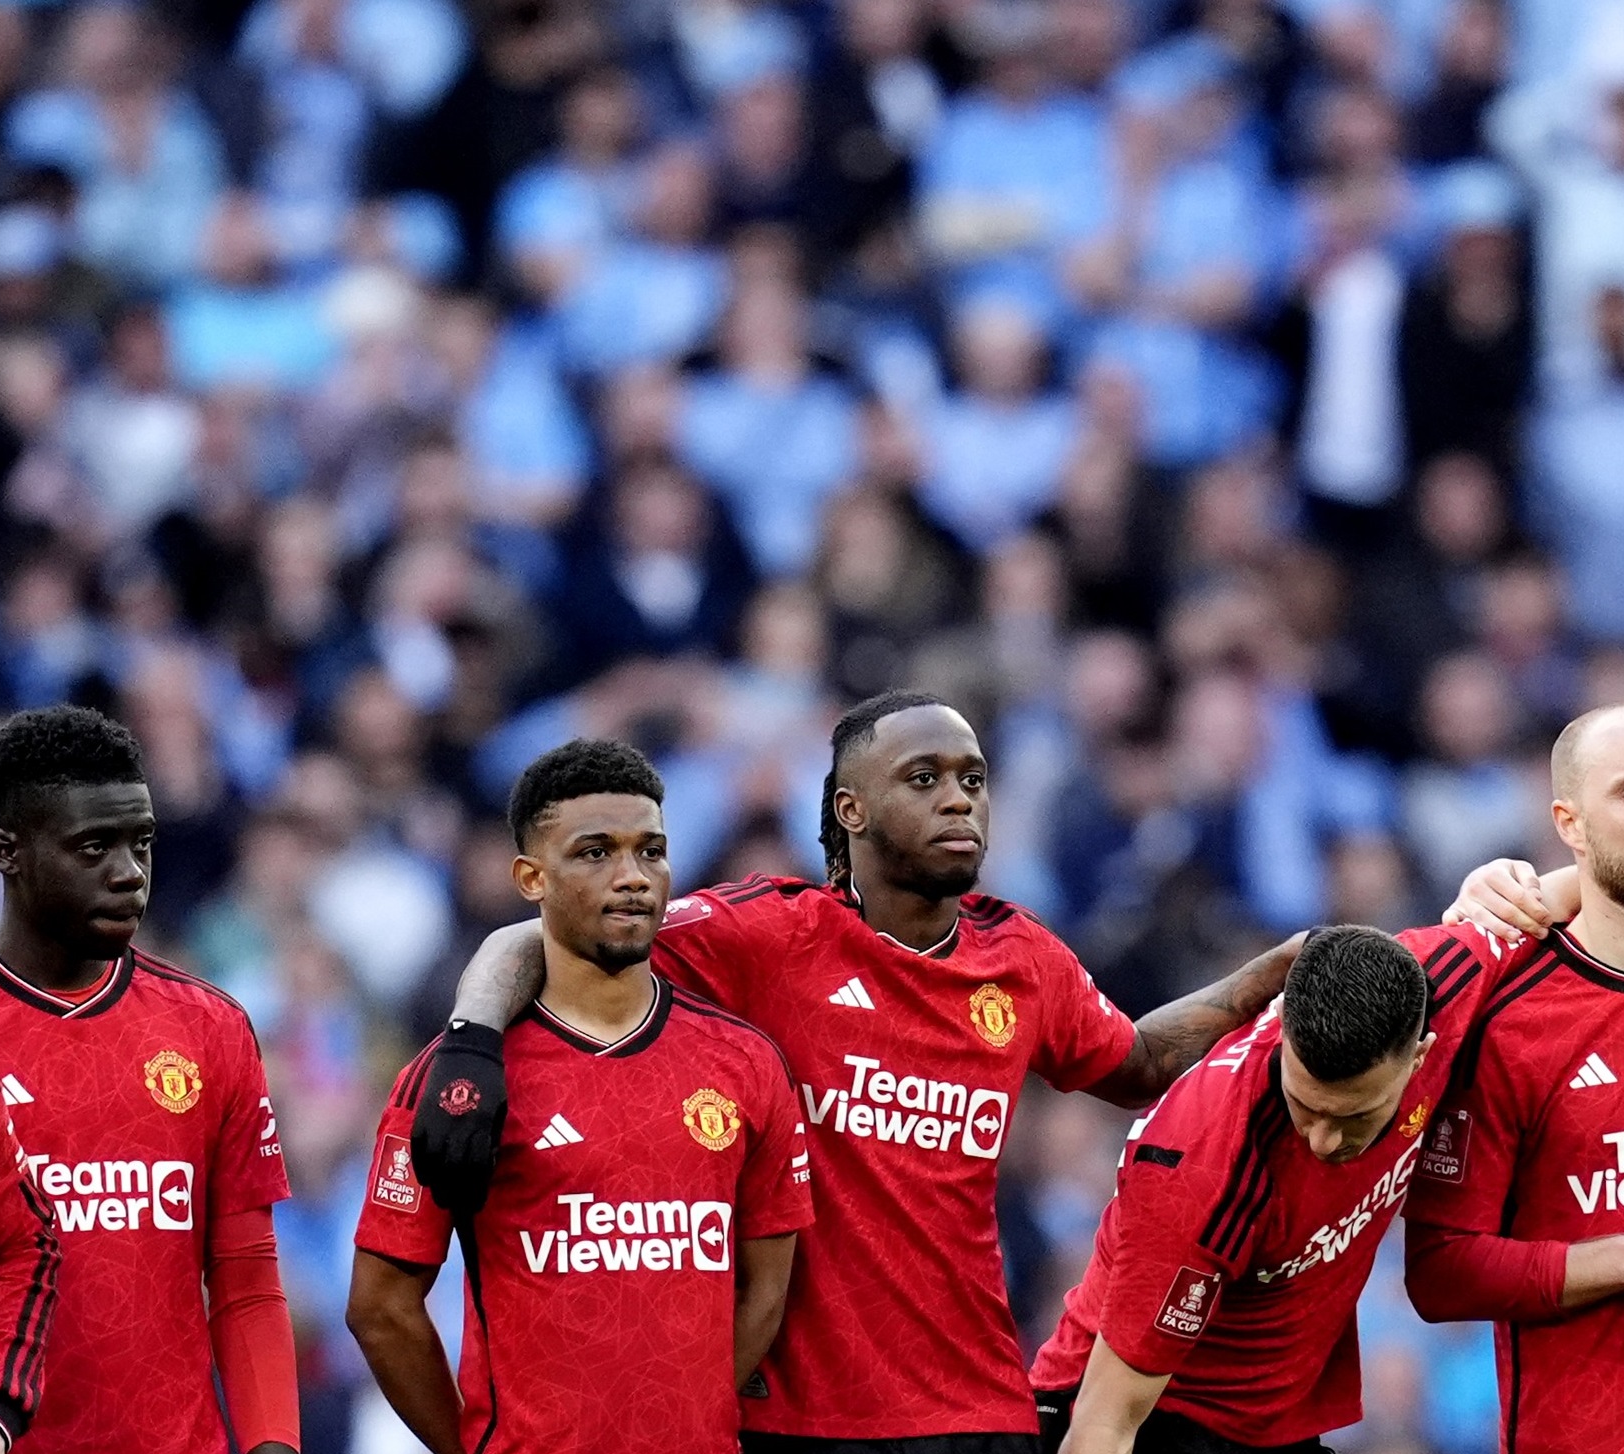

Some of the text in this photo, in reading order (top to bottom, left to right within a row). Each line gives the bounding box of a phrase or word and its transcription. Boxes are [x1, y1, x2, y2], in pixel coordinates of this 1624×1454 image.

[843, 1054, 968, 1117] Team
[160, 1095, 193, 1110] UNITED
[801, 1083, 962, 1152] Viewer
[698, 1134, 730, 1149] UNITED
[27, 1154, 148, 1193] Team
[1434, 1162, 1458, 1176] CUP
[376, 1187, 414, 1206] FA CUP
[557, 1192, 688, 1236] Team
[519, 1230, 691, 1274] Viewer
[1161, 1314, 1200, 1333] FA CUP
